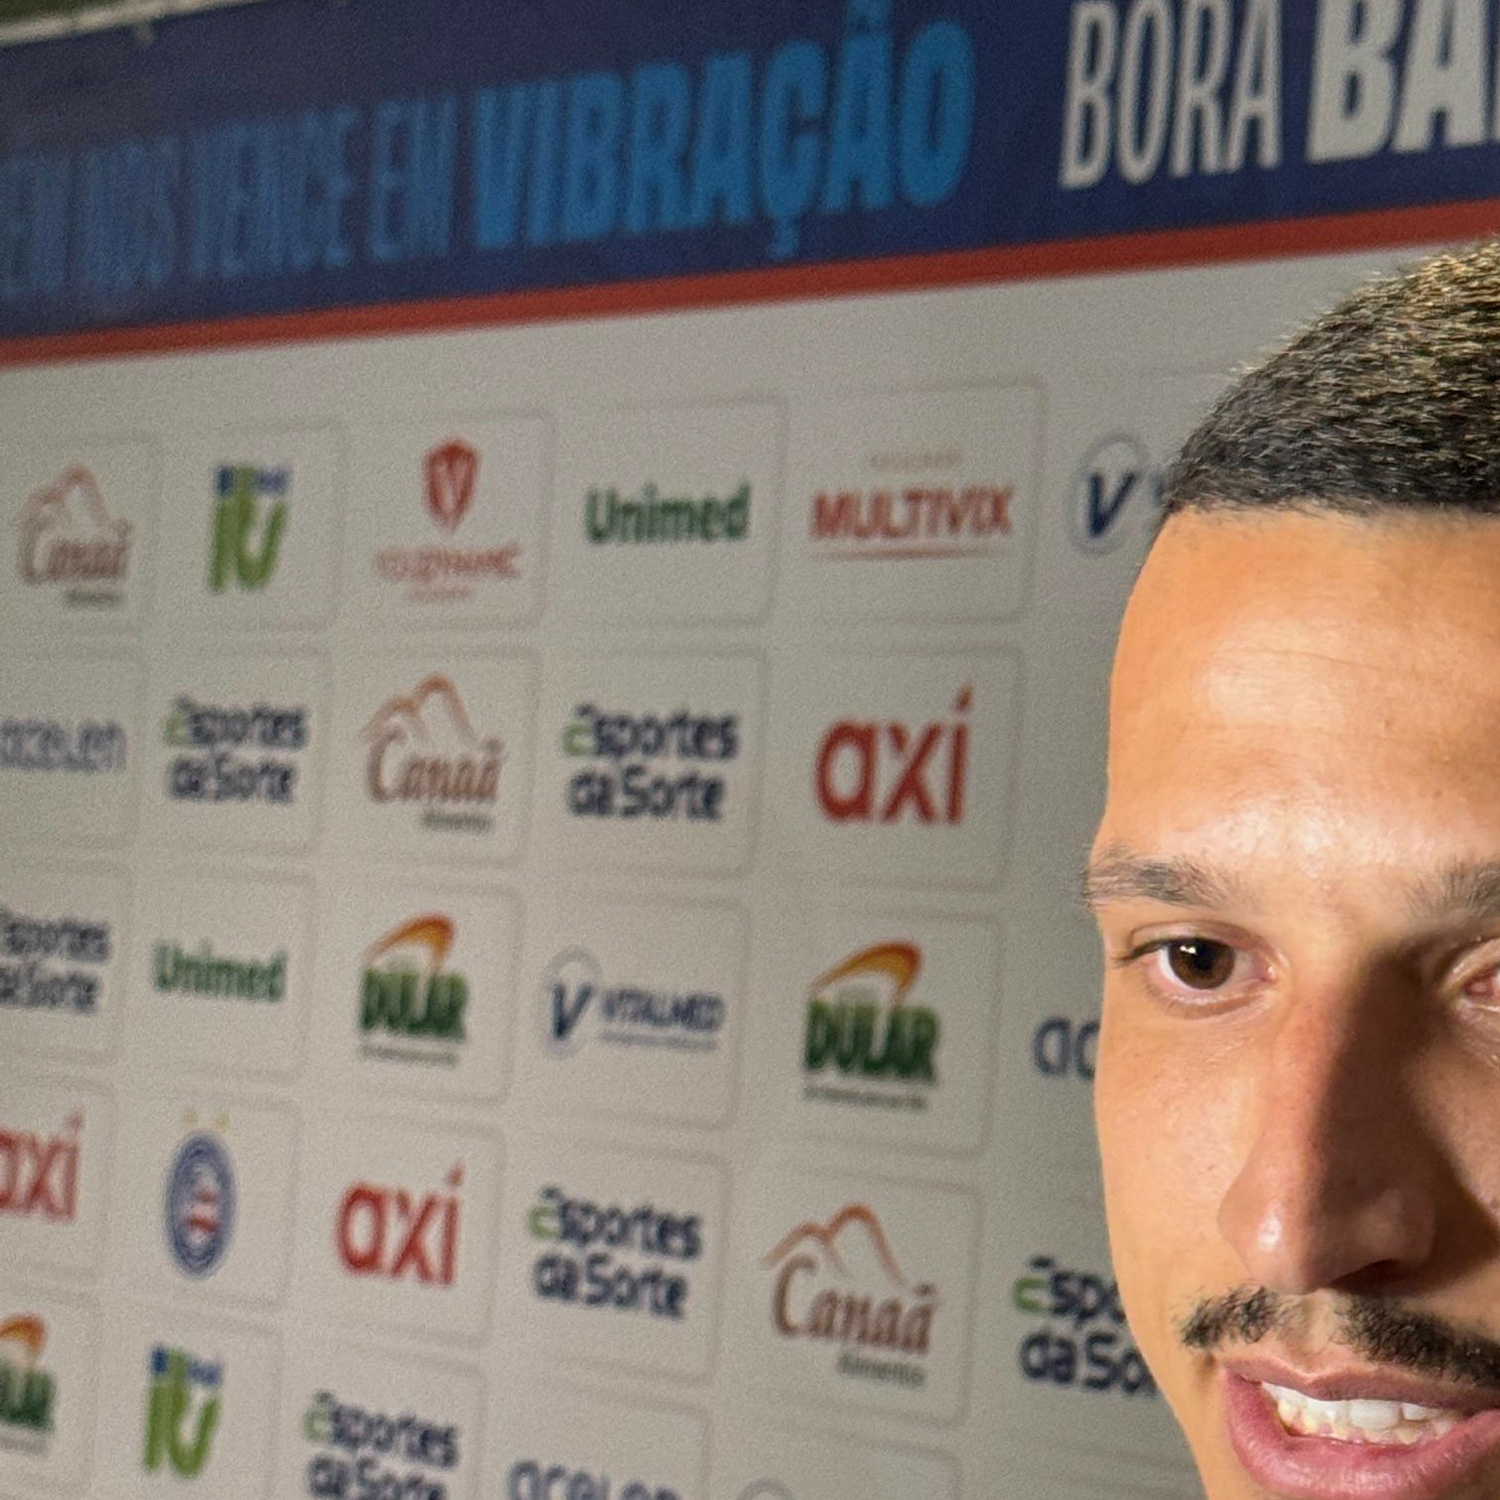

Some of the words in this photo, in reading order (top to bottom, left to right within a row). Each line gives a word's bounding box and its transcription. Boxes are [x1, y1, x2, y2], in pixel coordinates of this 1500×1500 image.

[473, 0, 976, 260] VIBRAÇÃO
[1060, 0, 1282, 190] BORA
[585, 478, 750, 545] Unimed
[804, 998, 940, 1086] DULAR
[772, 1254, 940, 1356] Canaã
